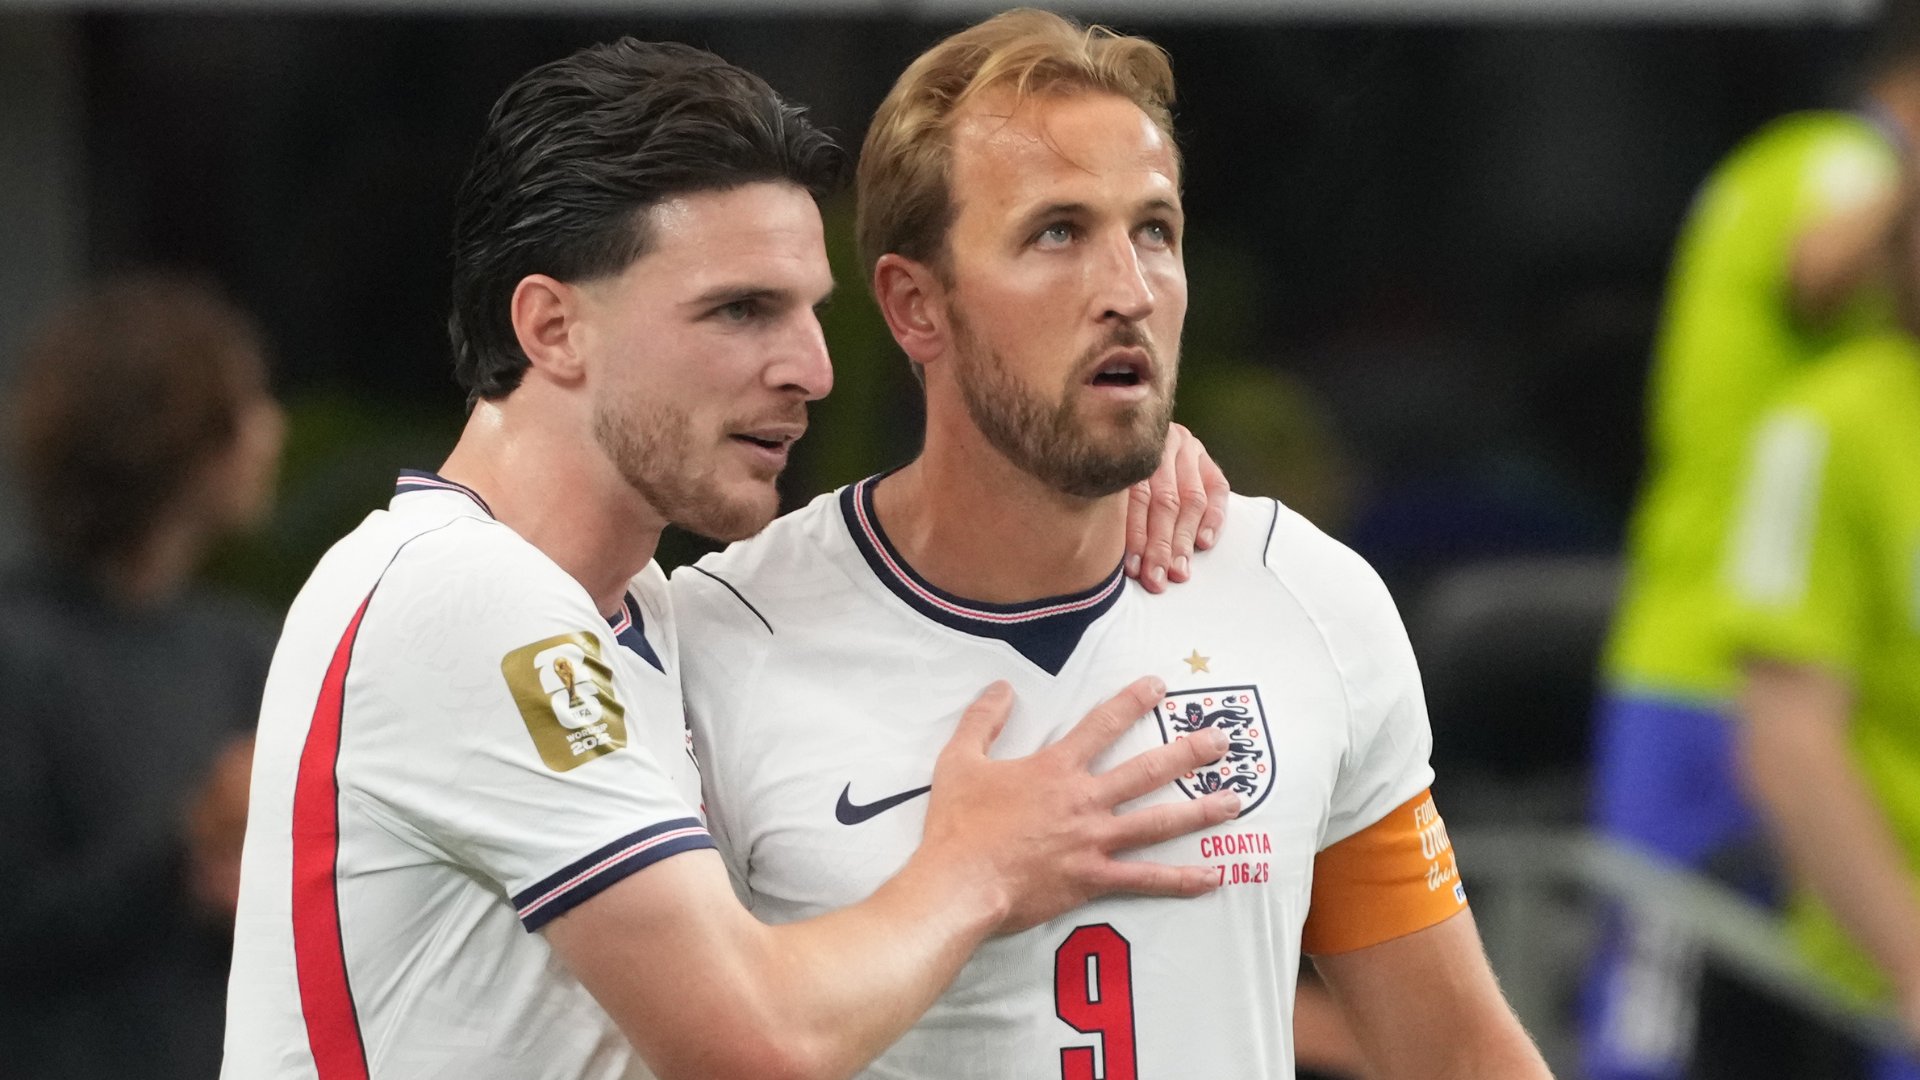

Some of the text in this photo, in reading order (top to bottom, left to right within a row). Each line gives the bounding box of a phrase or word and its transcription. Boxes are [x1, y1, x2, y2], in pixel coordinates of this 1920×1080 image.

[1200, 833, 1271, 858] CROATIA
[1212, 862, 1269, 887] 7.06.26
[1054, 922, 1138, 1080] 9
